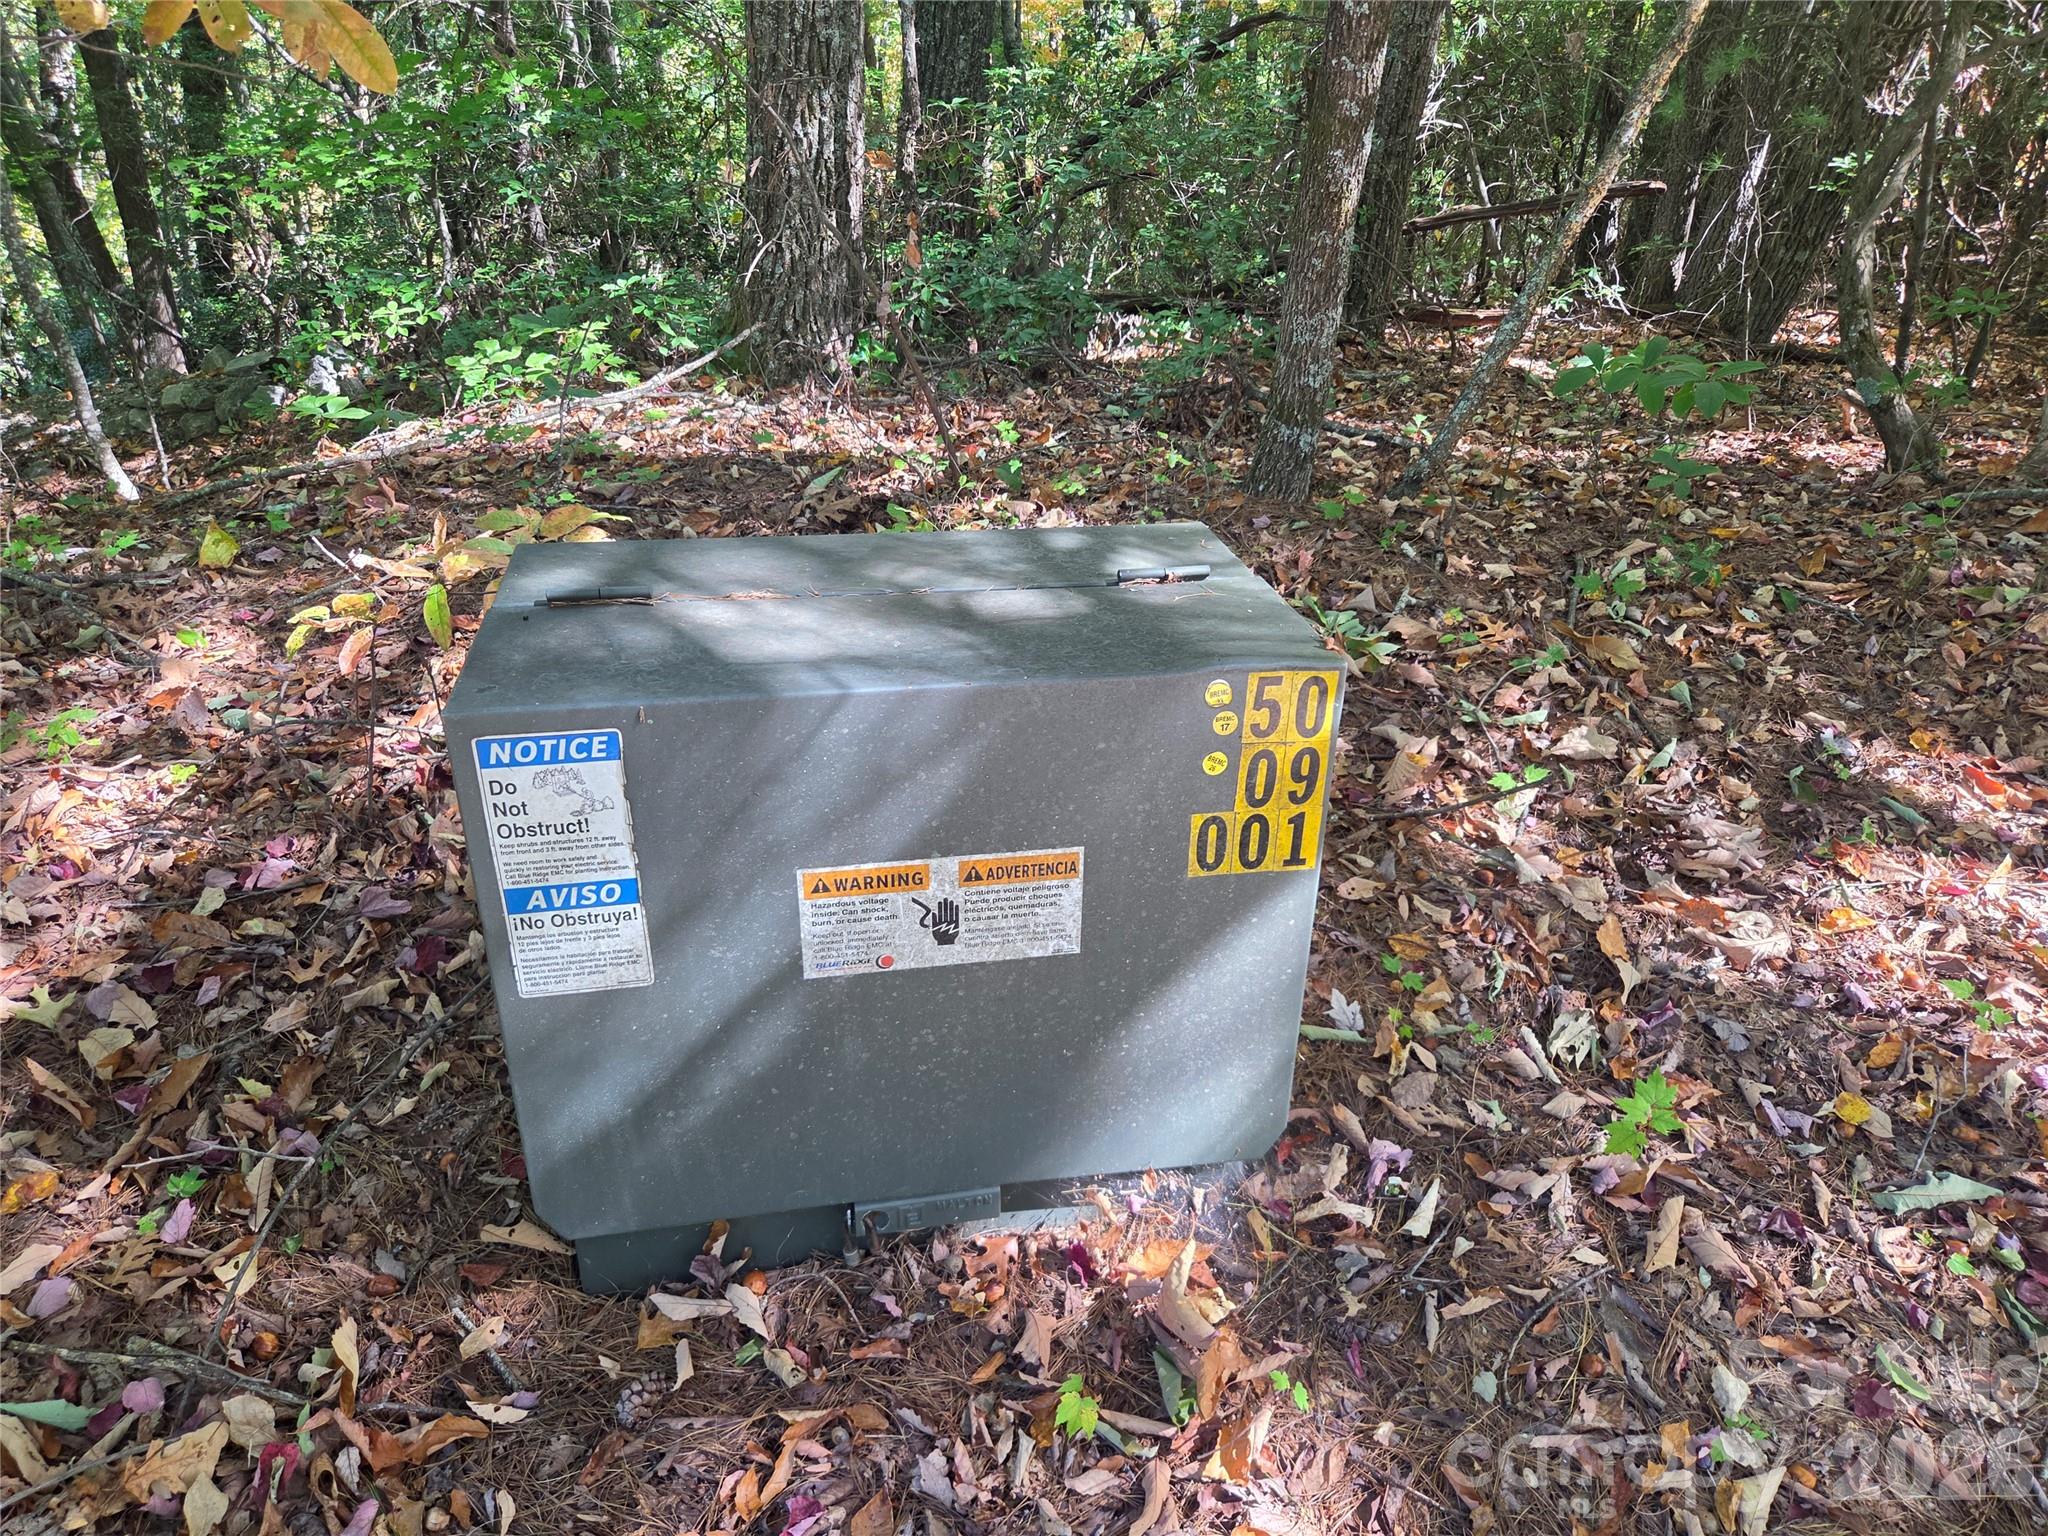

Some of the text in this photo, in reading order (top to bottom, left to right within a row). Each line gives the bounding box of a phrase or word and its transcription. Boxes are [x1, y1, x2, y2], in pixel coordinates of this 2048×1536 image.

[1250, 676, 1328, 738] 50
[489, 736, 608, 765] NOTICE
[1245, 747, 1320, 808] 09
[488, 780, 517, 796] Do
[492, 801, 528, 817] Not
[497, 818, 590, 839] Obstruct!
[1196, 812, 1306, 872] 001
[986, 861, 1077, 881] ADVERTENCIA
[834, 872, 923, 892] WARNING
[1003, 886, 1030, 894] voltaje
[527, 884, 621, 910] AVISO
[811, 901, 856, 909] Hazardous
[992, 895, 1026, 904] producir
[1028, 892, 1062, 900] choques
[512, 907, 638, 931] ¡No Obstruya!
